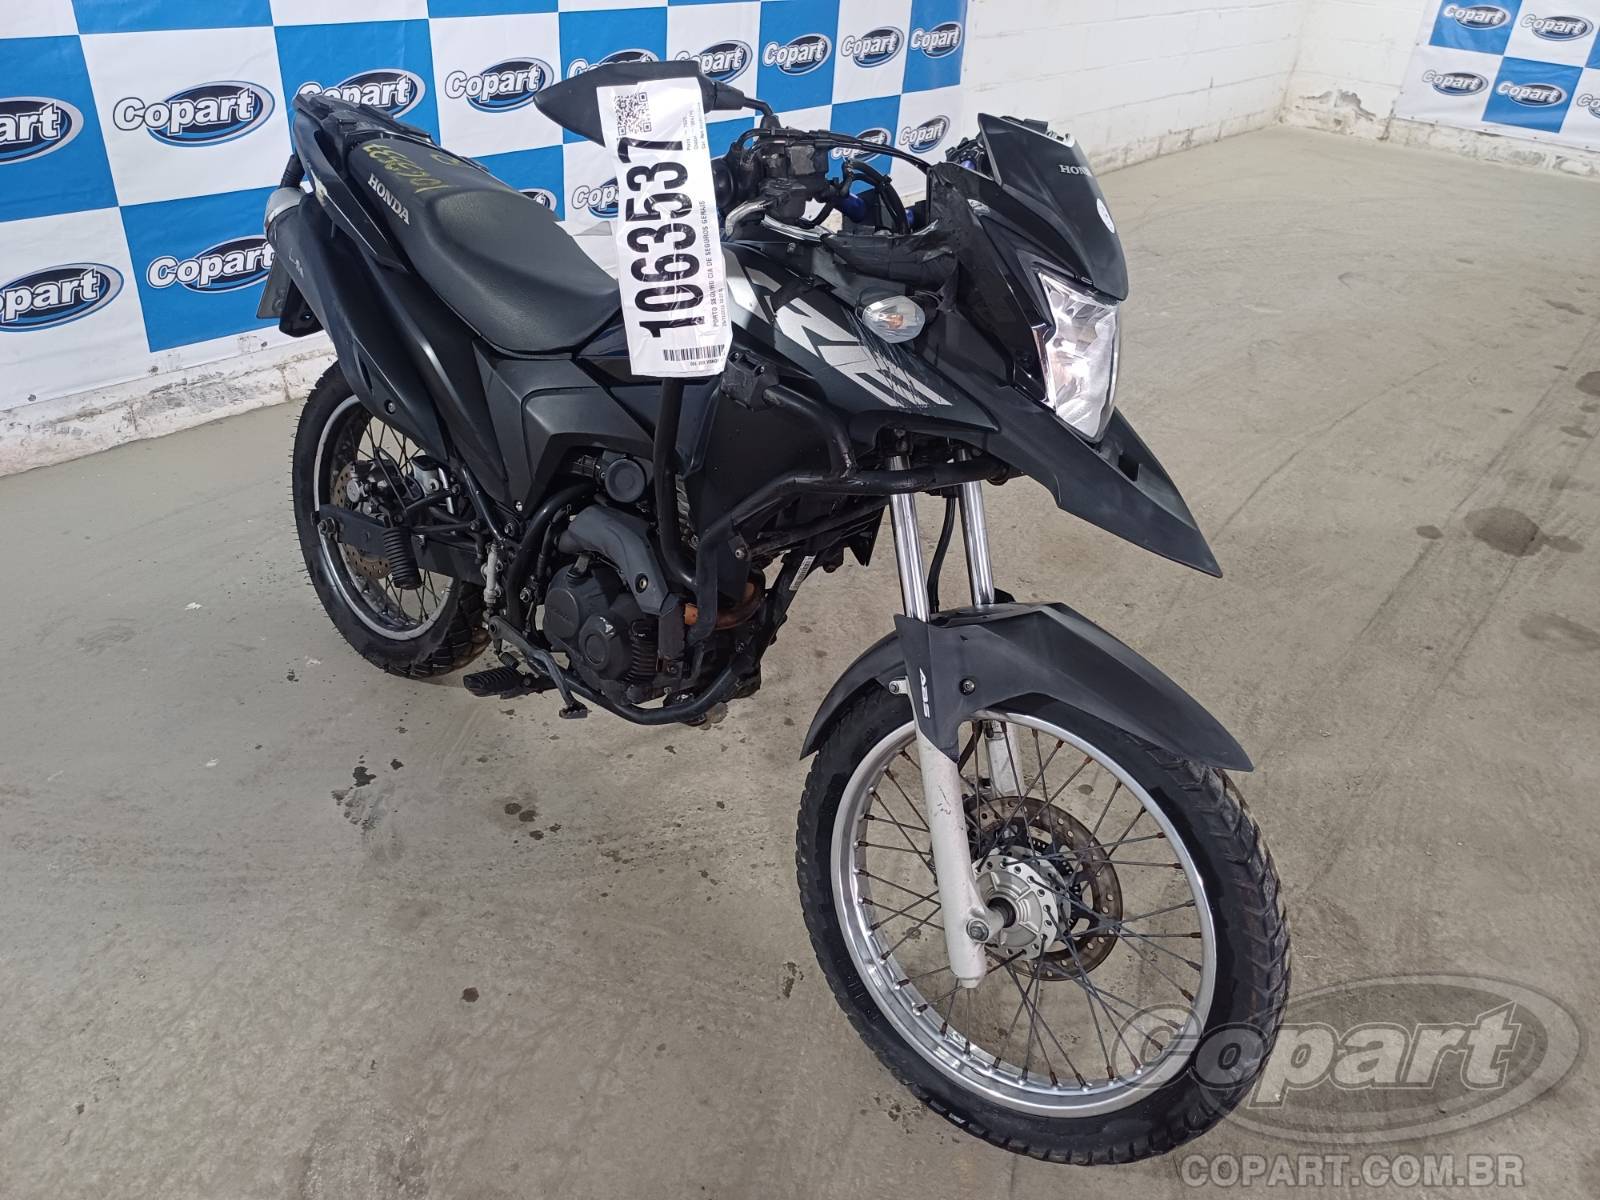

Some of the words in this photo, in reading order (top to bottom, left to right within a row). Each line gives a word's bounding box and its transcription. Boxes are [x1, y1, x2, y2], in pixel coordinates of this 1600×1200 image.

[1444, 4, 1504, 25] Copart
[1520, 14, 1585, 36] Copart
[842, 31, 897, 59] Copart
[910, 26, 960, 51] Copart
[675, 45, 745, 74] part
[763, 37, 825, 70] Copart
[445, 64, 541, 103] Copart
[1422, 69, 1484, 90] Copart
[1497, 81, 1562, 105] Copart
[113, 87, 254, 136] Copart
[900, 121, 945, 148] Copart
[367, 173, 410, 225] HONDA
[571, 185, 619, 210] Cop
[617, 137, 705, 338] 1063537
[147, 241, 275, 288] Copart
[0, 266, 101, 322] part
